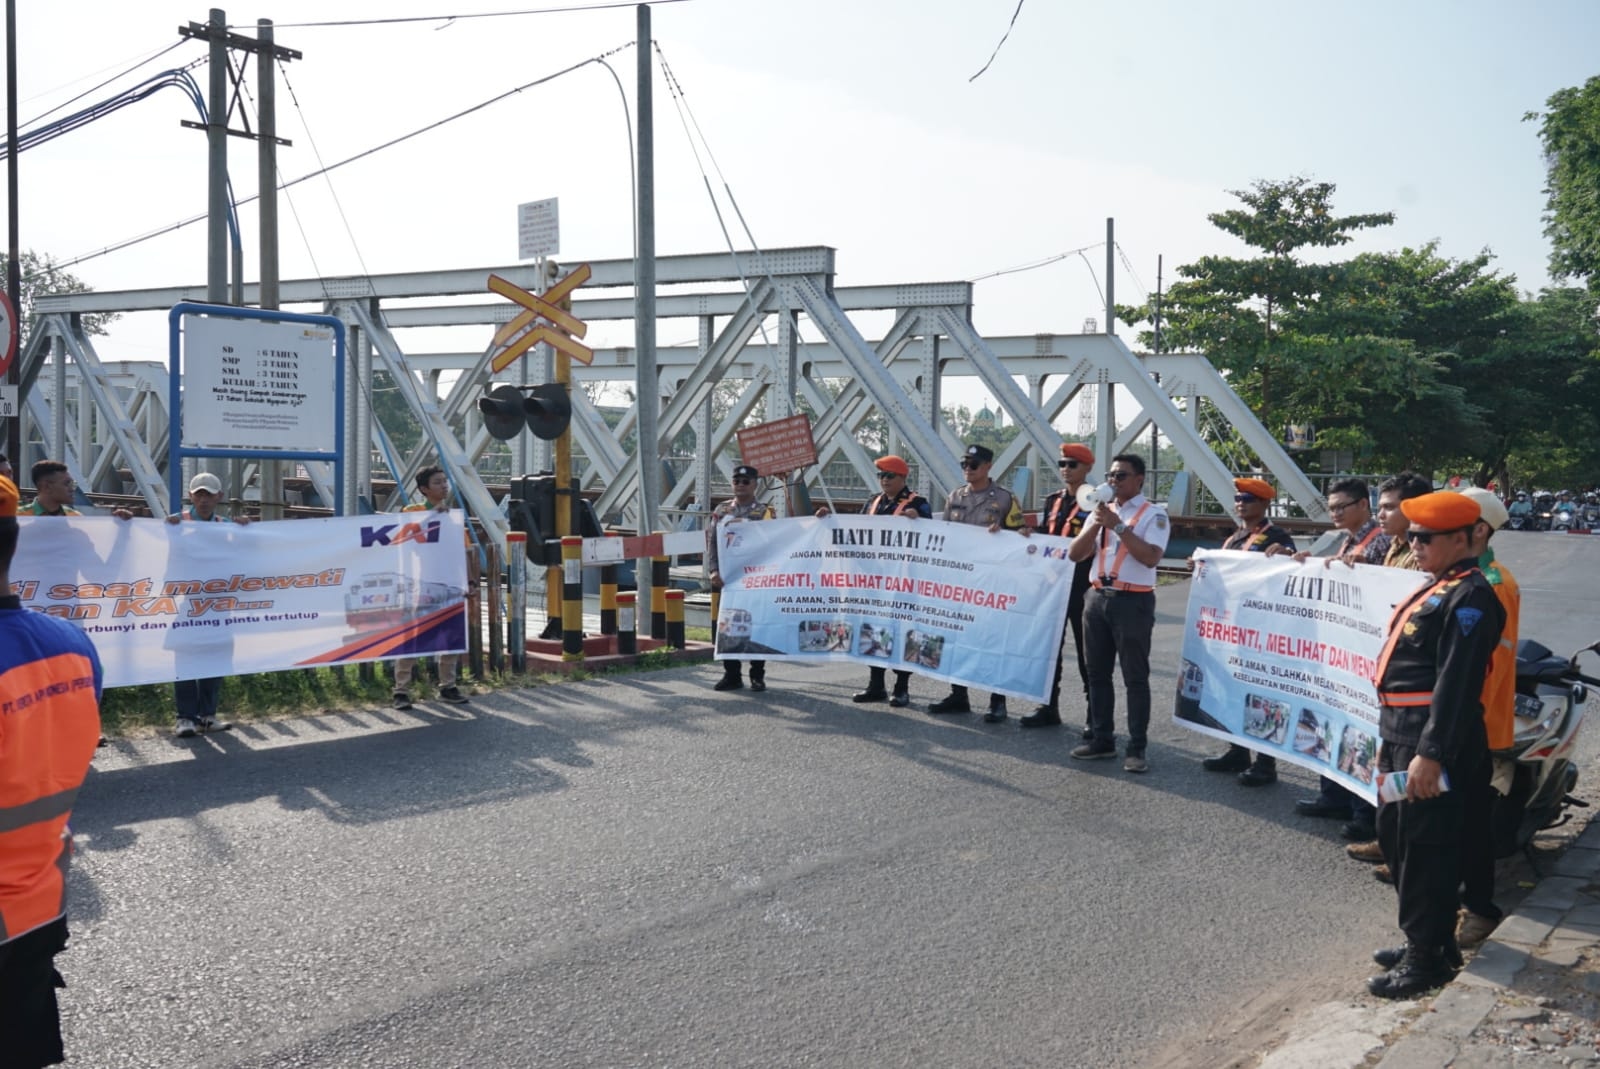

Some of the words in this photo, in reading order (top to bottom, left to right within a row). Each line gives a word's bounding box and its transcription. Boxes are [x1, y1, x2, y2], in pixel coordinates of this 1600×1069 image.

[270, 350, 299, 359] TAHUN
[270, 360, 299, 369] TAHUN
[222, 378, 255, 387] KULIAH
[270, 381, 299, 390] TAHUN
[270, 371, 299, 380] TAHUN
[361, 521, 441, 548] KAI
[832, 528, 874, 546] HATI
[880, 530, 920, 549] HATI
[925, 534, 946, 552] !!!
[790, 551, 822, 560] JANGAN
[825, 551, 876, 560] MENEROBOS
[930, 558, 974, 572] SEBIDANG
[1043, 546, 1068, 560] KAI
[47, 578, 152, 600] saat
[160, 568, 346, 596] melewati
[820, 573, 884, 590] MELIHAT
[885, 576, 914, 593] DAN
[1284, 575, 1324, 600] HATI
[1328, 580, 1350, 608] HATI
[112, 597, 178, 618] KA
[796, 596, 826, 605] AMAN,
[828, 596, 870, 606] SILAHKAN
[922, 606, 975, 622] PERJALANAN
[1242, 599, 1273, 612] JANGAN
[1275, 603, 1324, 620] MENEROBOS
[141, 622, 167, 630] dan
[172, 618, 220, 629] palang
[224, 615, 260, 626] pintu
[264, 612, 319, 622] tertutup
[930, 619, 964, 632] BERSAMA
[1266, 632, 1326, 662] MELIHAT
[1328, 646, 1350, 671] DAN
[1228, 656, 1244, 668] JIKA
[1270, 666, 1312, 684] SILAHKAN
[1233, 672, 1278, 689] KESELAMATAN
[1280, 682, 1320, 700] MERUPAKAN
